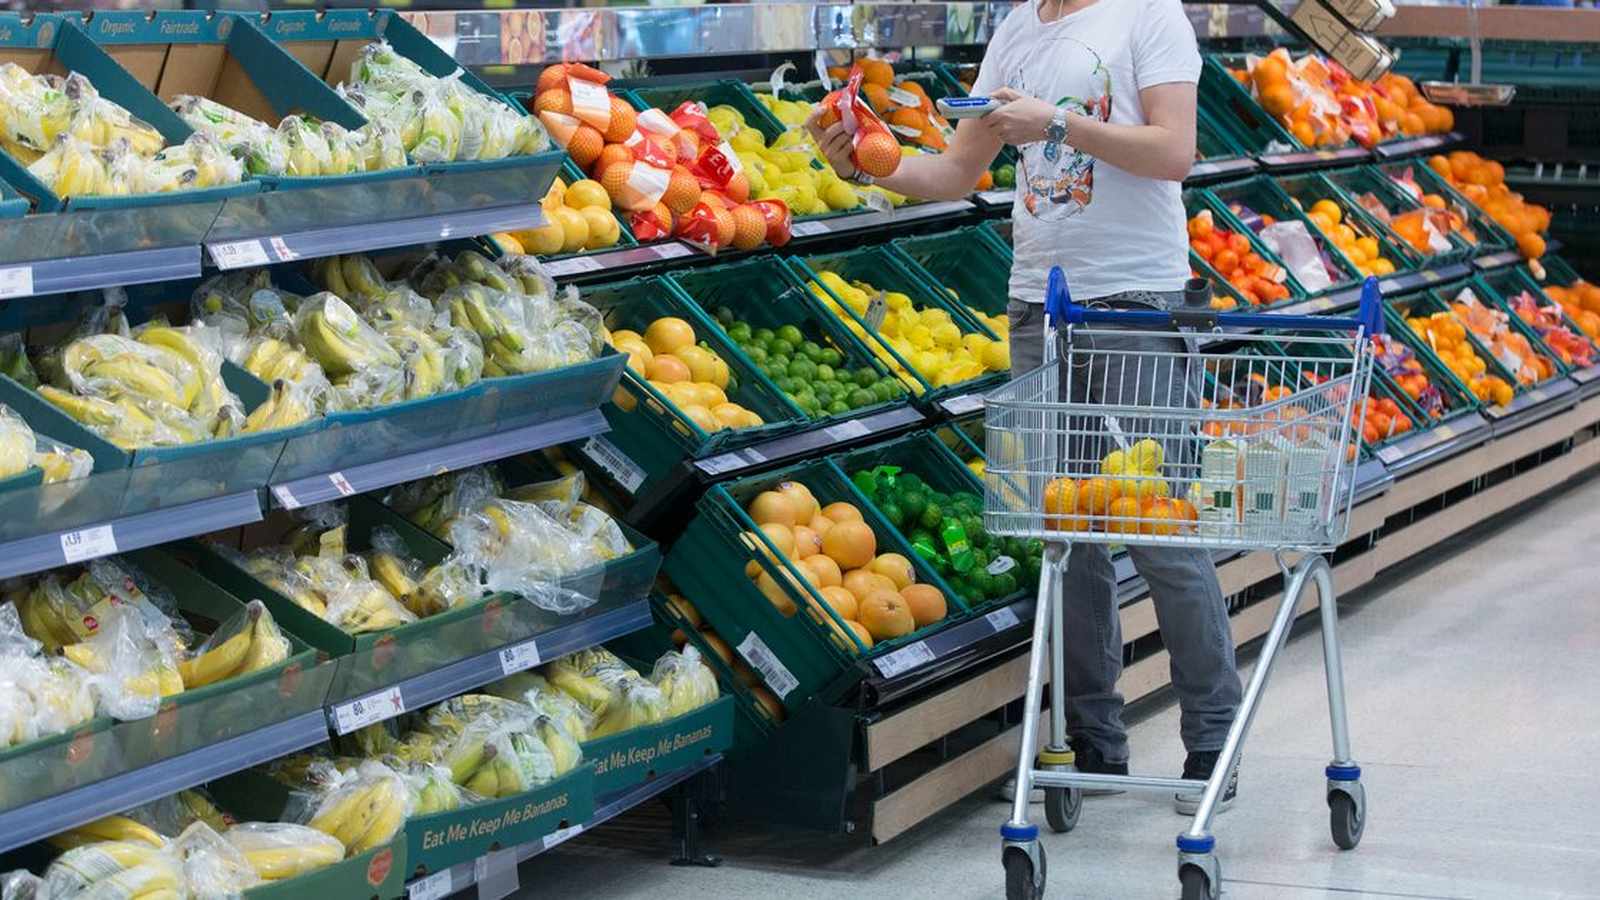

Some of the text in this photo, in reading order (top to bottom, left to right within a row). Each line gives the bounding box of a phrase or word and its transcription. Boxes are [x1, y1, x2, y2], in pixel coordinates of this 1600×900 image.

[101, 19, 200, 36] Organic Fairtrade
[610, 751, 626, 770] Me
[627, 746, 656, 765] Keep
[657, 737, 672, 757] Me
[672, 724, 713, 751] Bananas
[422, 793, 569, 850] Eat Me Keep Me Bananas
